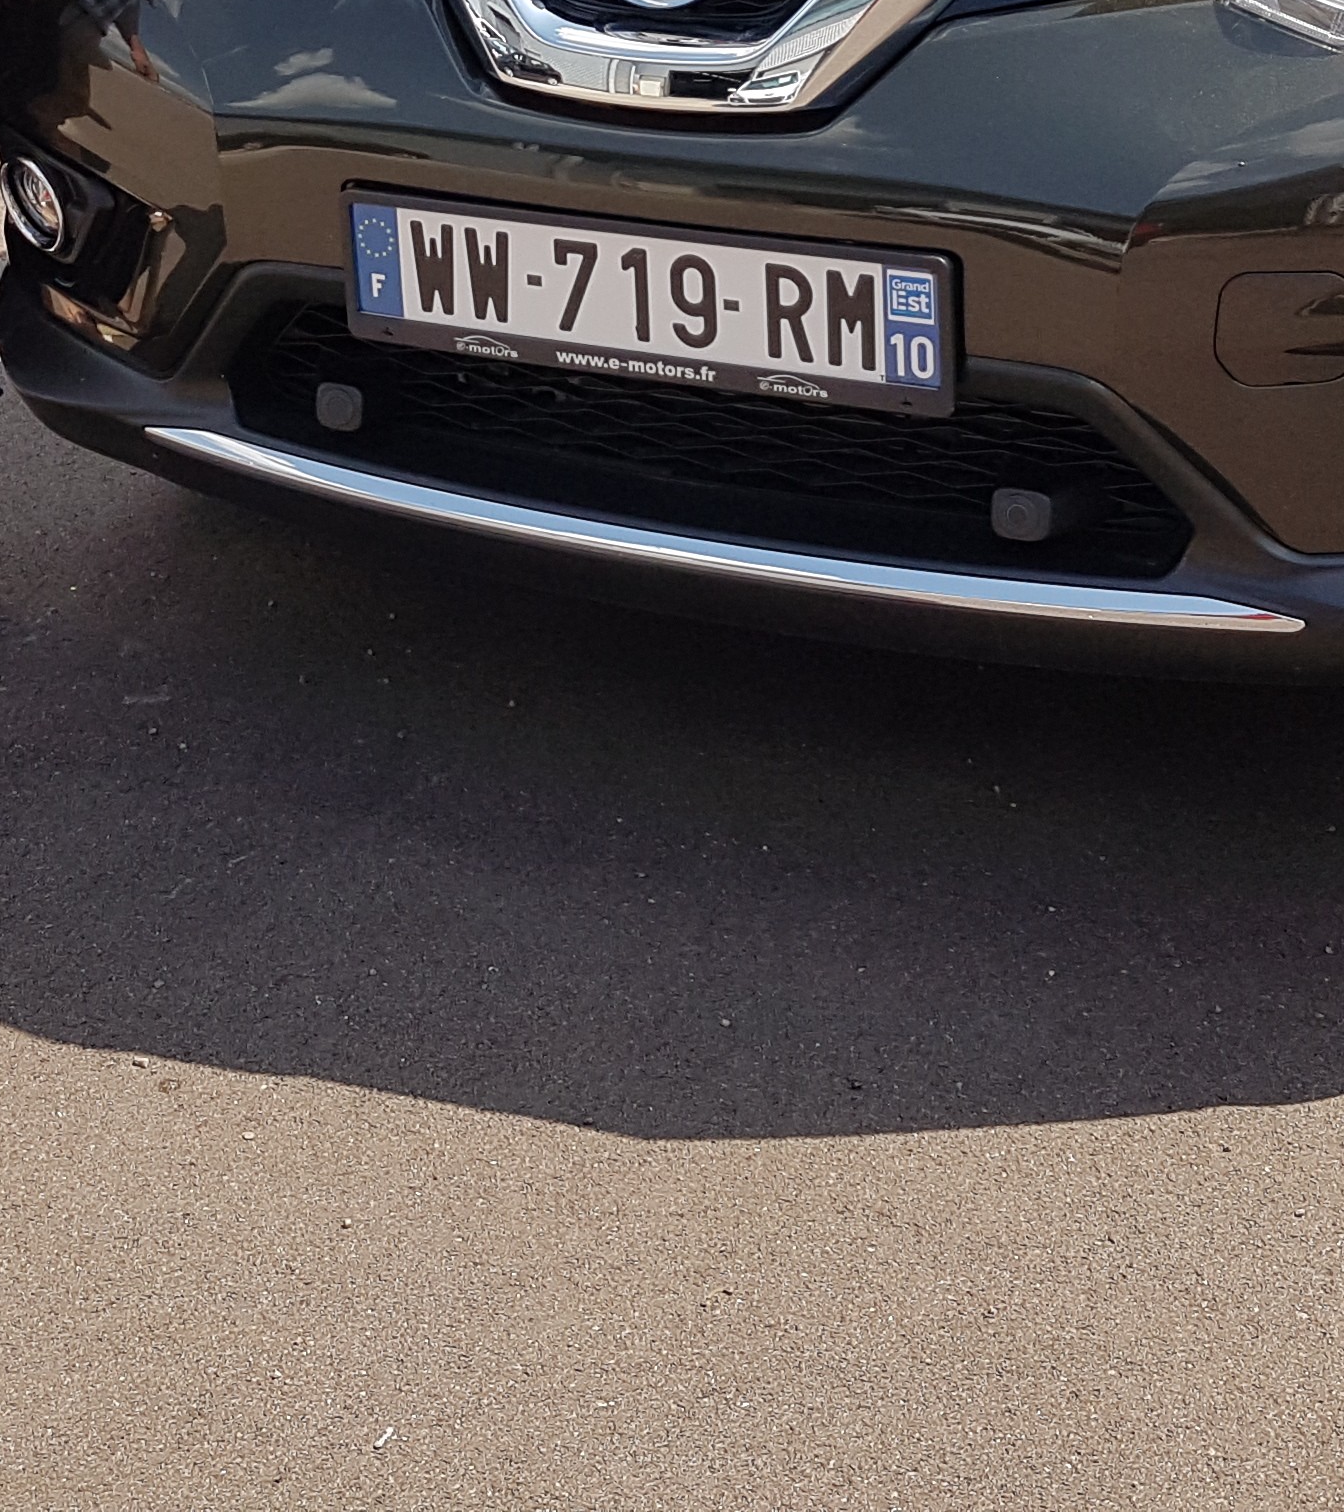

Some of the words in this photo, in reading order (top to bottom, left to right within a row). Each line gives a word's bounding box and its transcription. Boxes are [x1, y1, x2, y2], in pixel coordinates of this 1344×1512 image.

[371, 272, 386, 298] F
[892, 278, 930, 293] Grand
[892, 290, 930, 314] Est
[556, 350, 717, 382] www.e-motors.fr
[890, 333, 935, 379] 10
